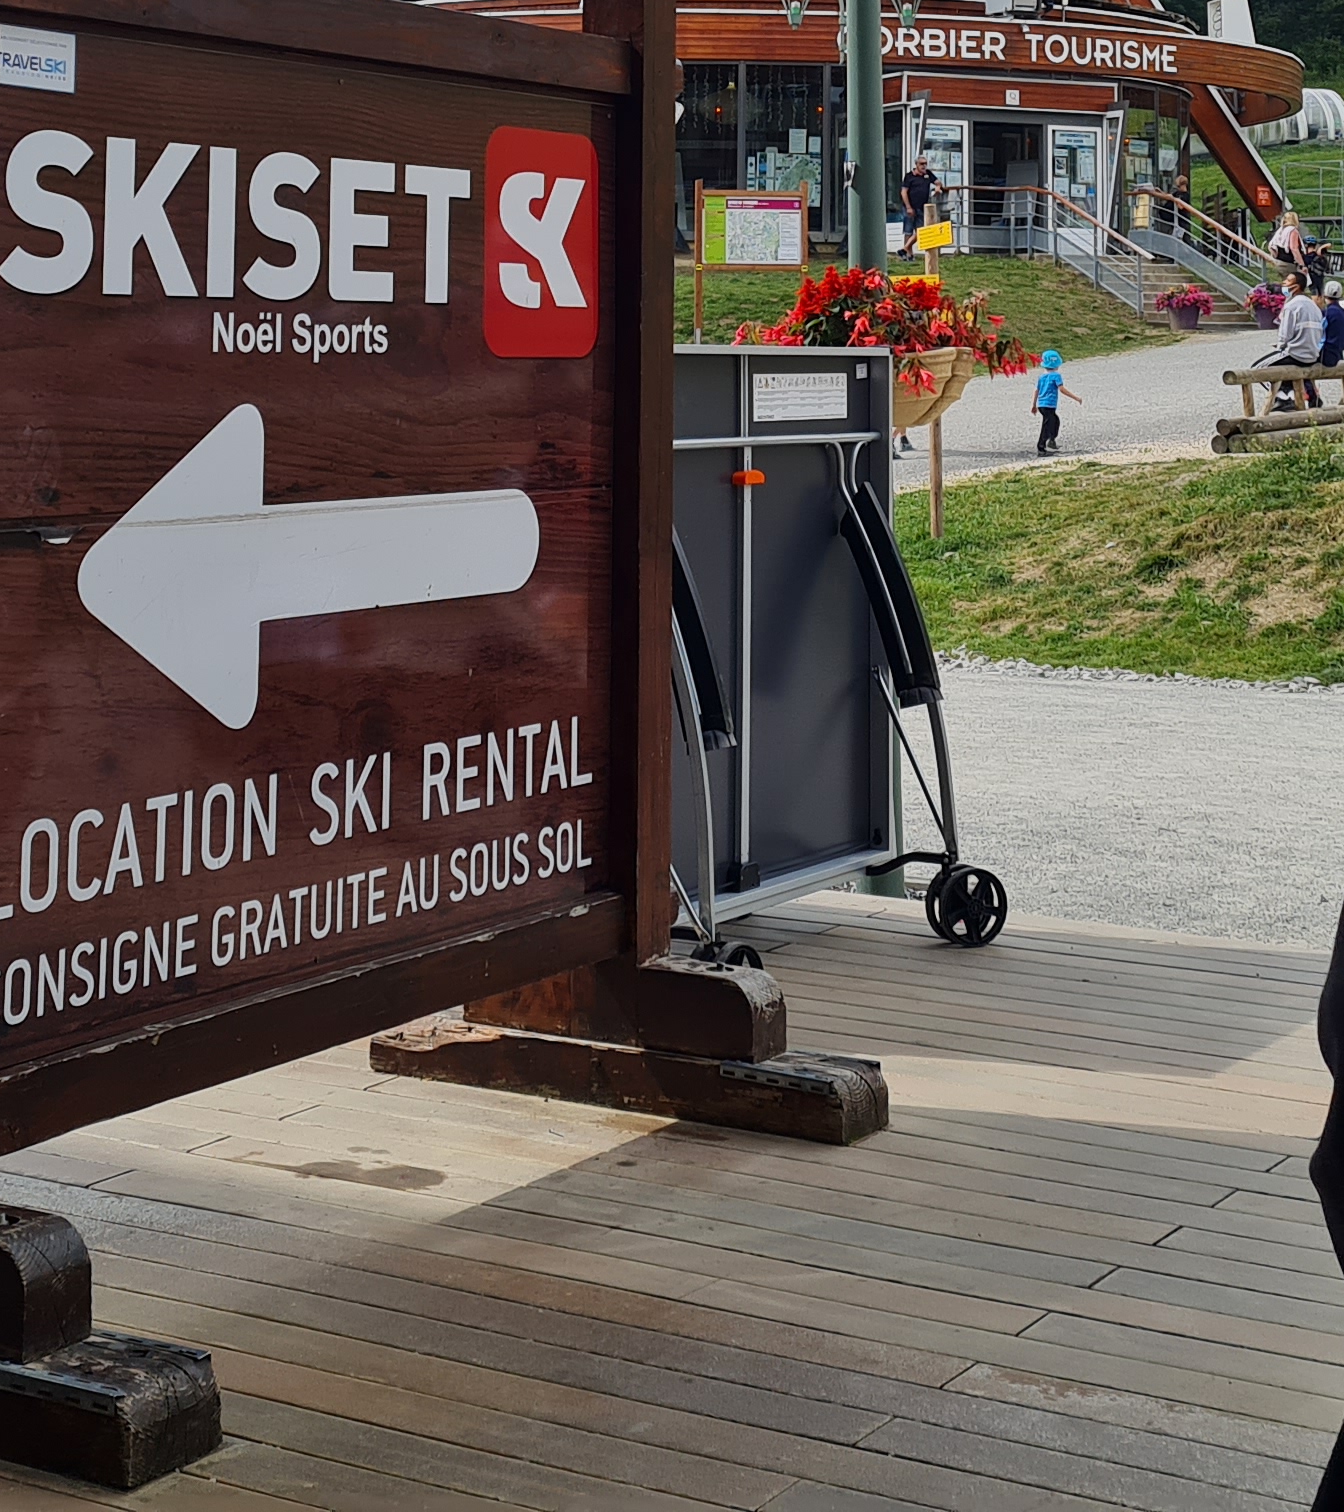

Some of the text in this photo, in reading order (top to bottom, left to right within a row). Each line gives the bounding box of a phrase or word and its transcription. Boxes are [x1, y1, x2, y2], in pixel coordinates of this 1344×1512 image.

[1024, 33, 1178, 73] TOURISME
[212, 311, 389, 364] Noël Sports
[309, 751, 391, 846] SKI
[421, 715, 593, 821] RENTAL
[210, 866, 387, 968] GRATUITE
[395, 858, 440, 918] AU
[448, 831, 531, 903] SOUS
[538, 818, 592, 880] SOL
